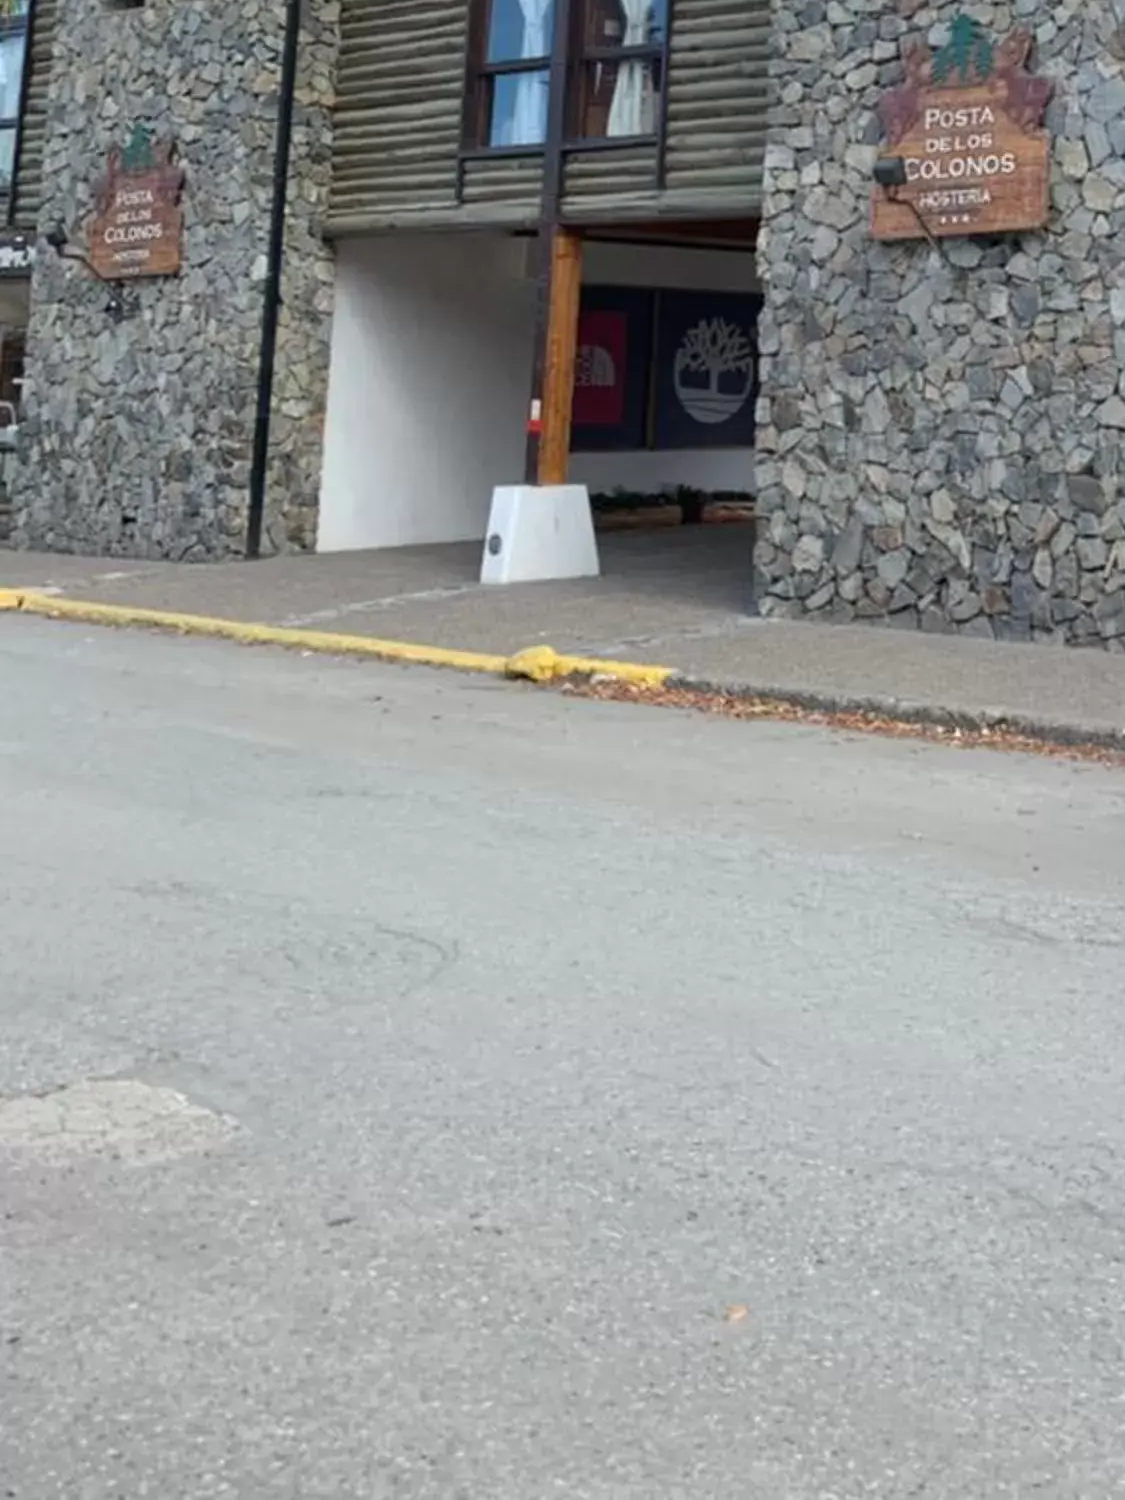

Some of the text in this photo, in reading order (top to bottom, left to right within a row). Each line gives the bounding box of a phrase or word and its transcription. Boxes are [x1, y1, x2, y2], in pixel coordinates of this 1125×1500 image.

[925, 106, 995, 130] POSTA
[926, 133, 992, 153] DE LOS
[904, 153, 1016, 181] COLONOS
[104, 223, 162, 243] COLONOS
